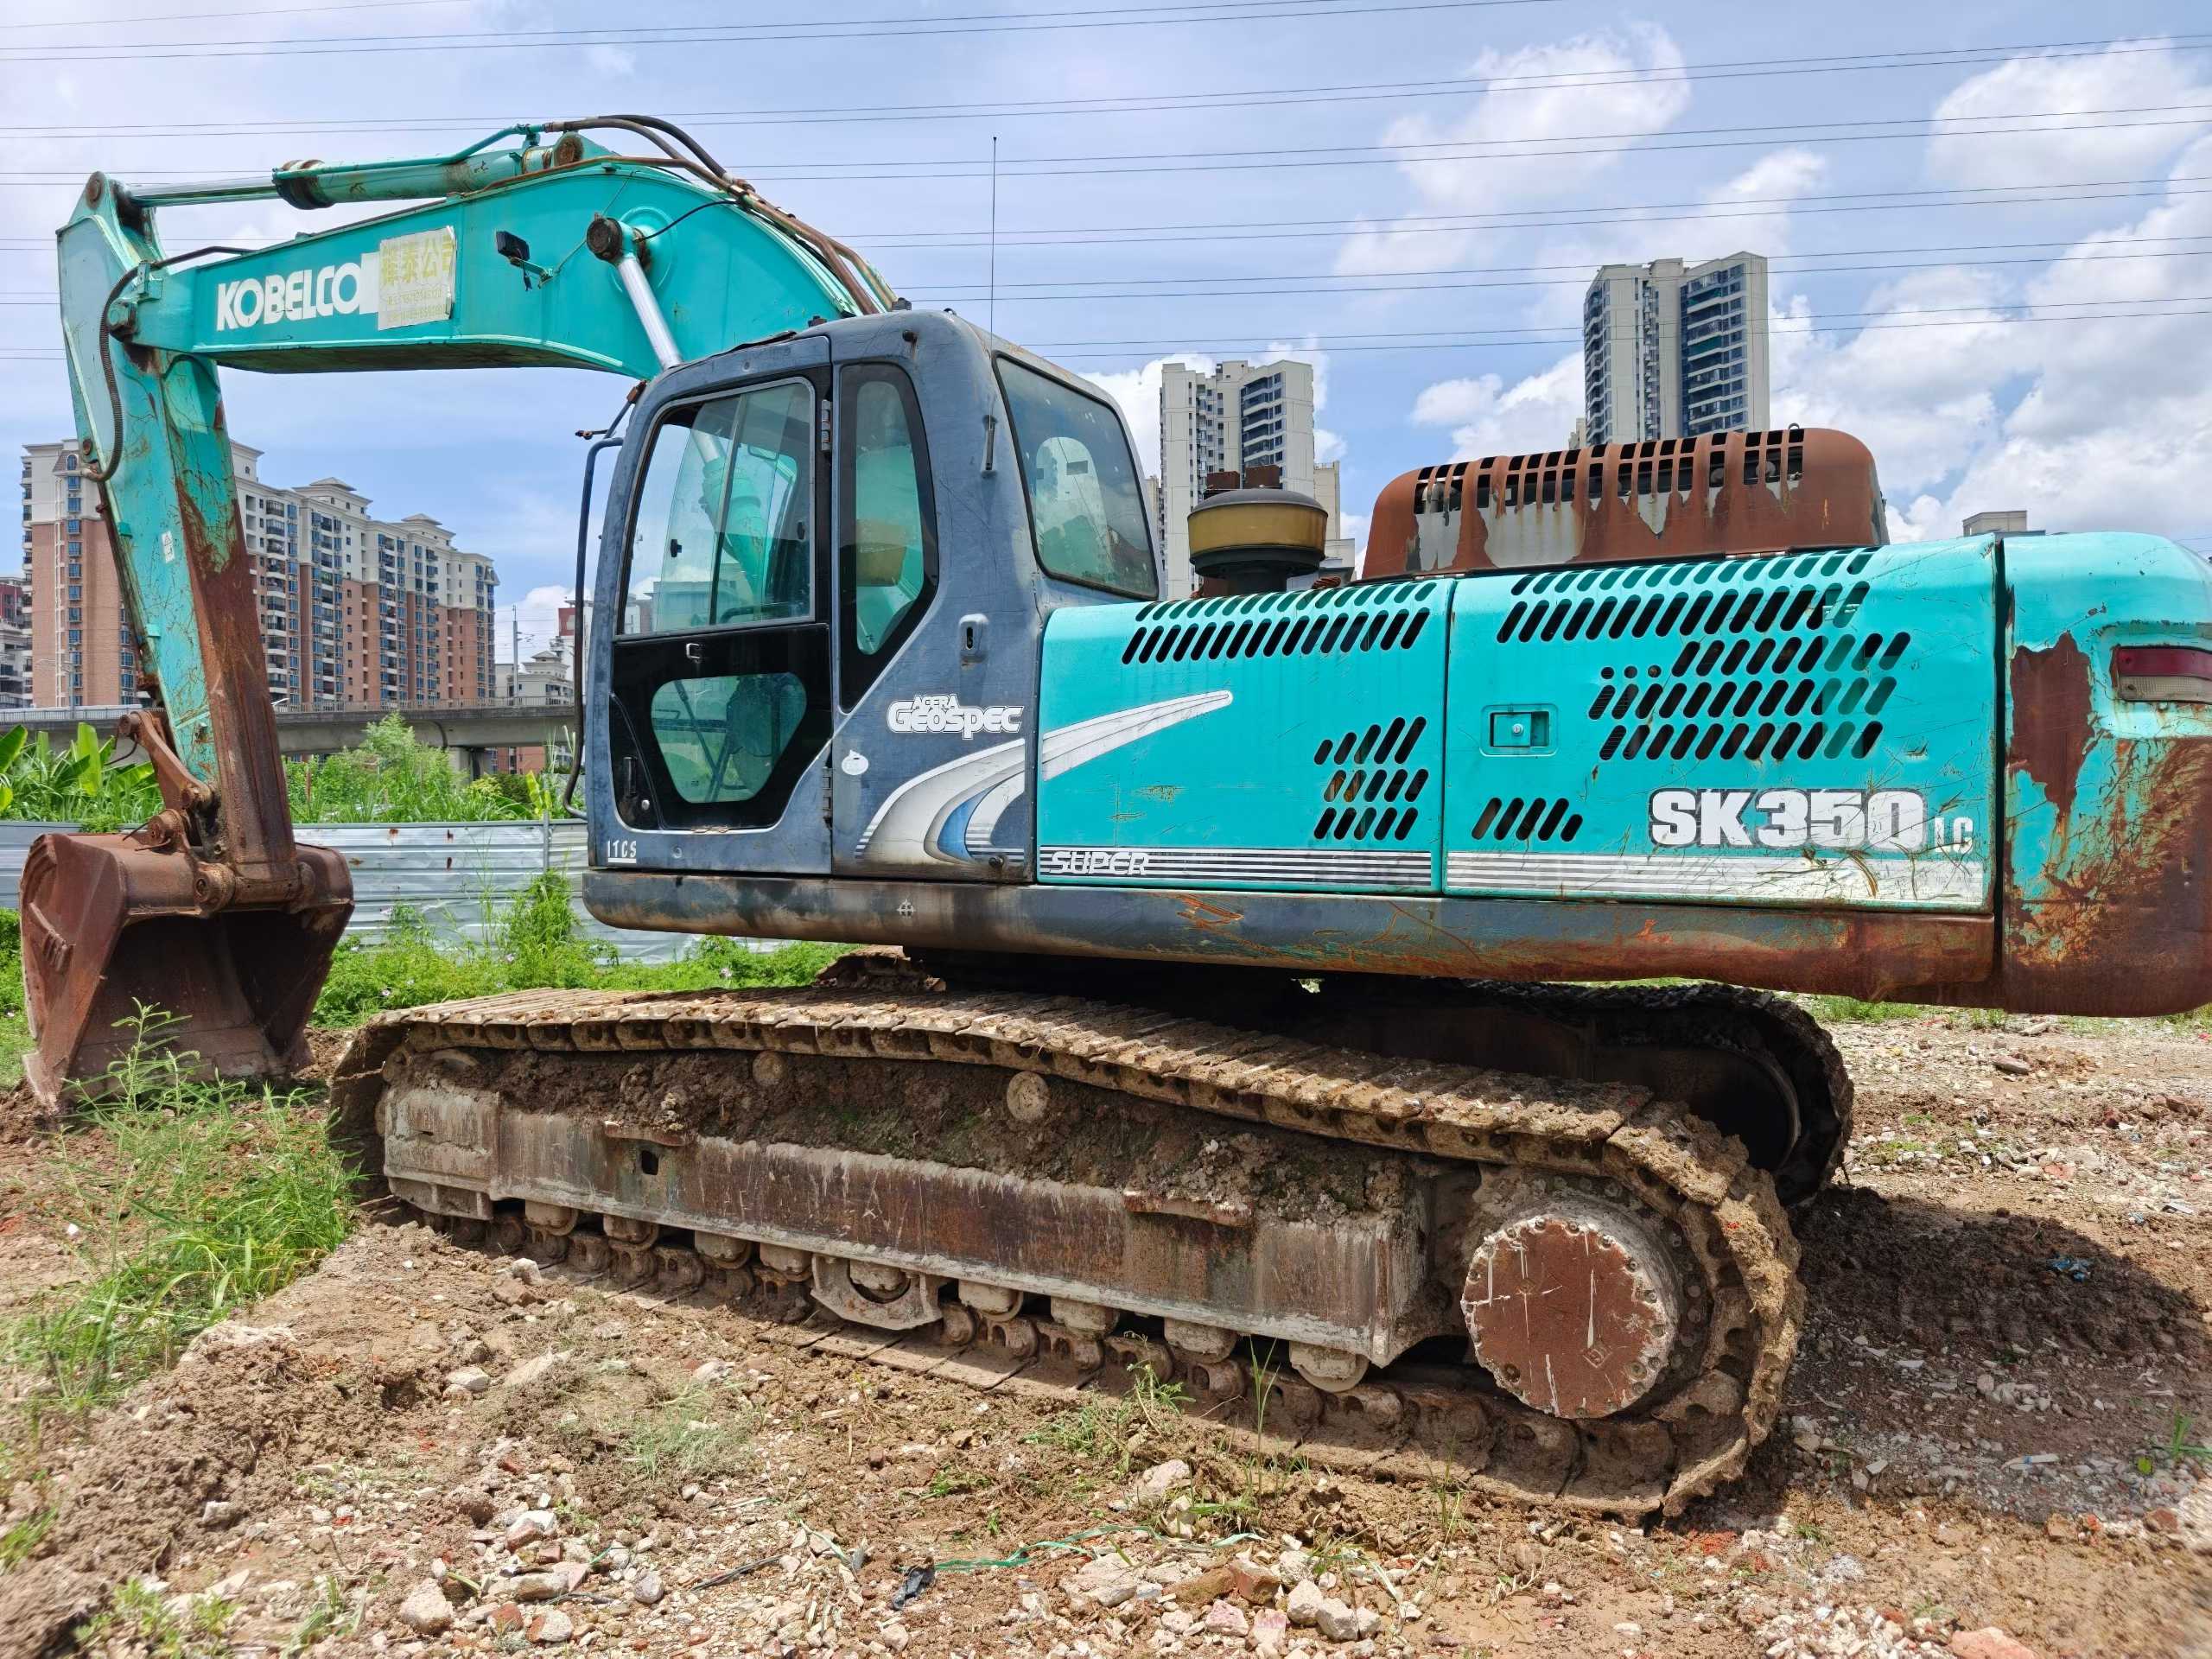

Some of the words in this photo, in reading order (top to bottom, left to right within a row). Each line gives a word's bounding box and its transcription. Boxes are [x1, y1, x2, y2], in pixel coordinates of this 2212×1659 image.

[217, 263, 360, 331] KOBELCO
[912, 694, 960, 710] ACERA
[1649, 788, 1928, 850] SK350
[1934, 817, 1974, 855] LC
[607, 840, 637, 858] ITCS
[1049, 850, 1149, 875] SUPER
